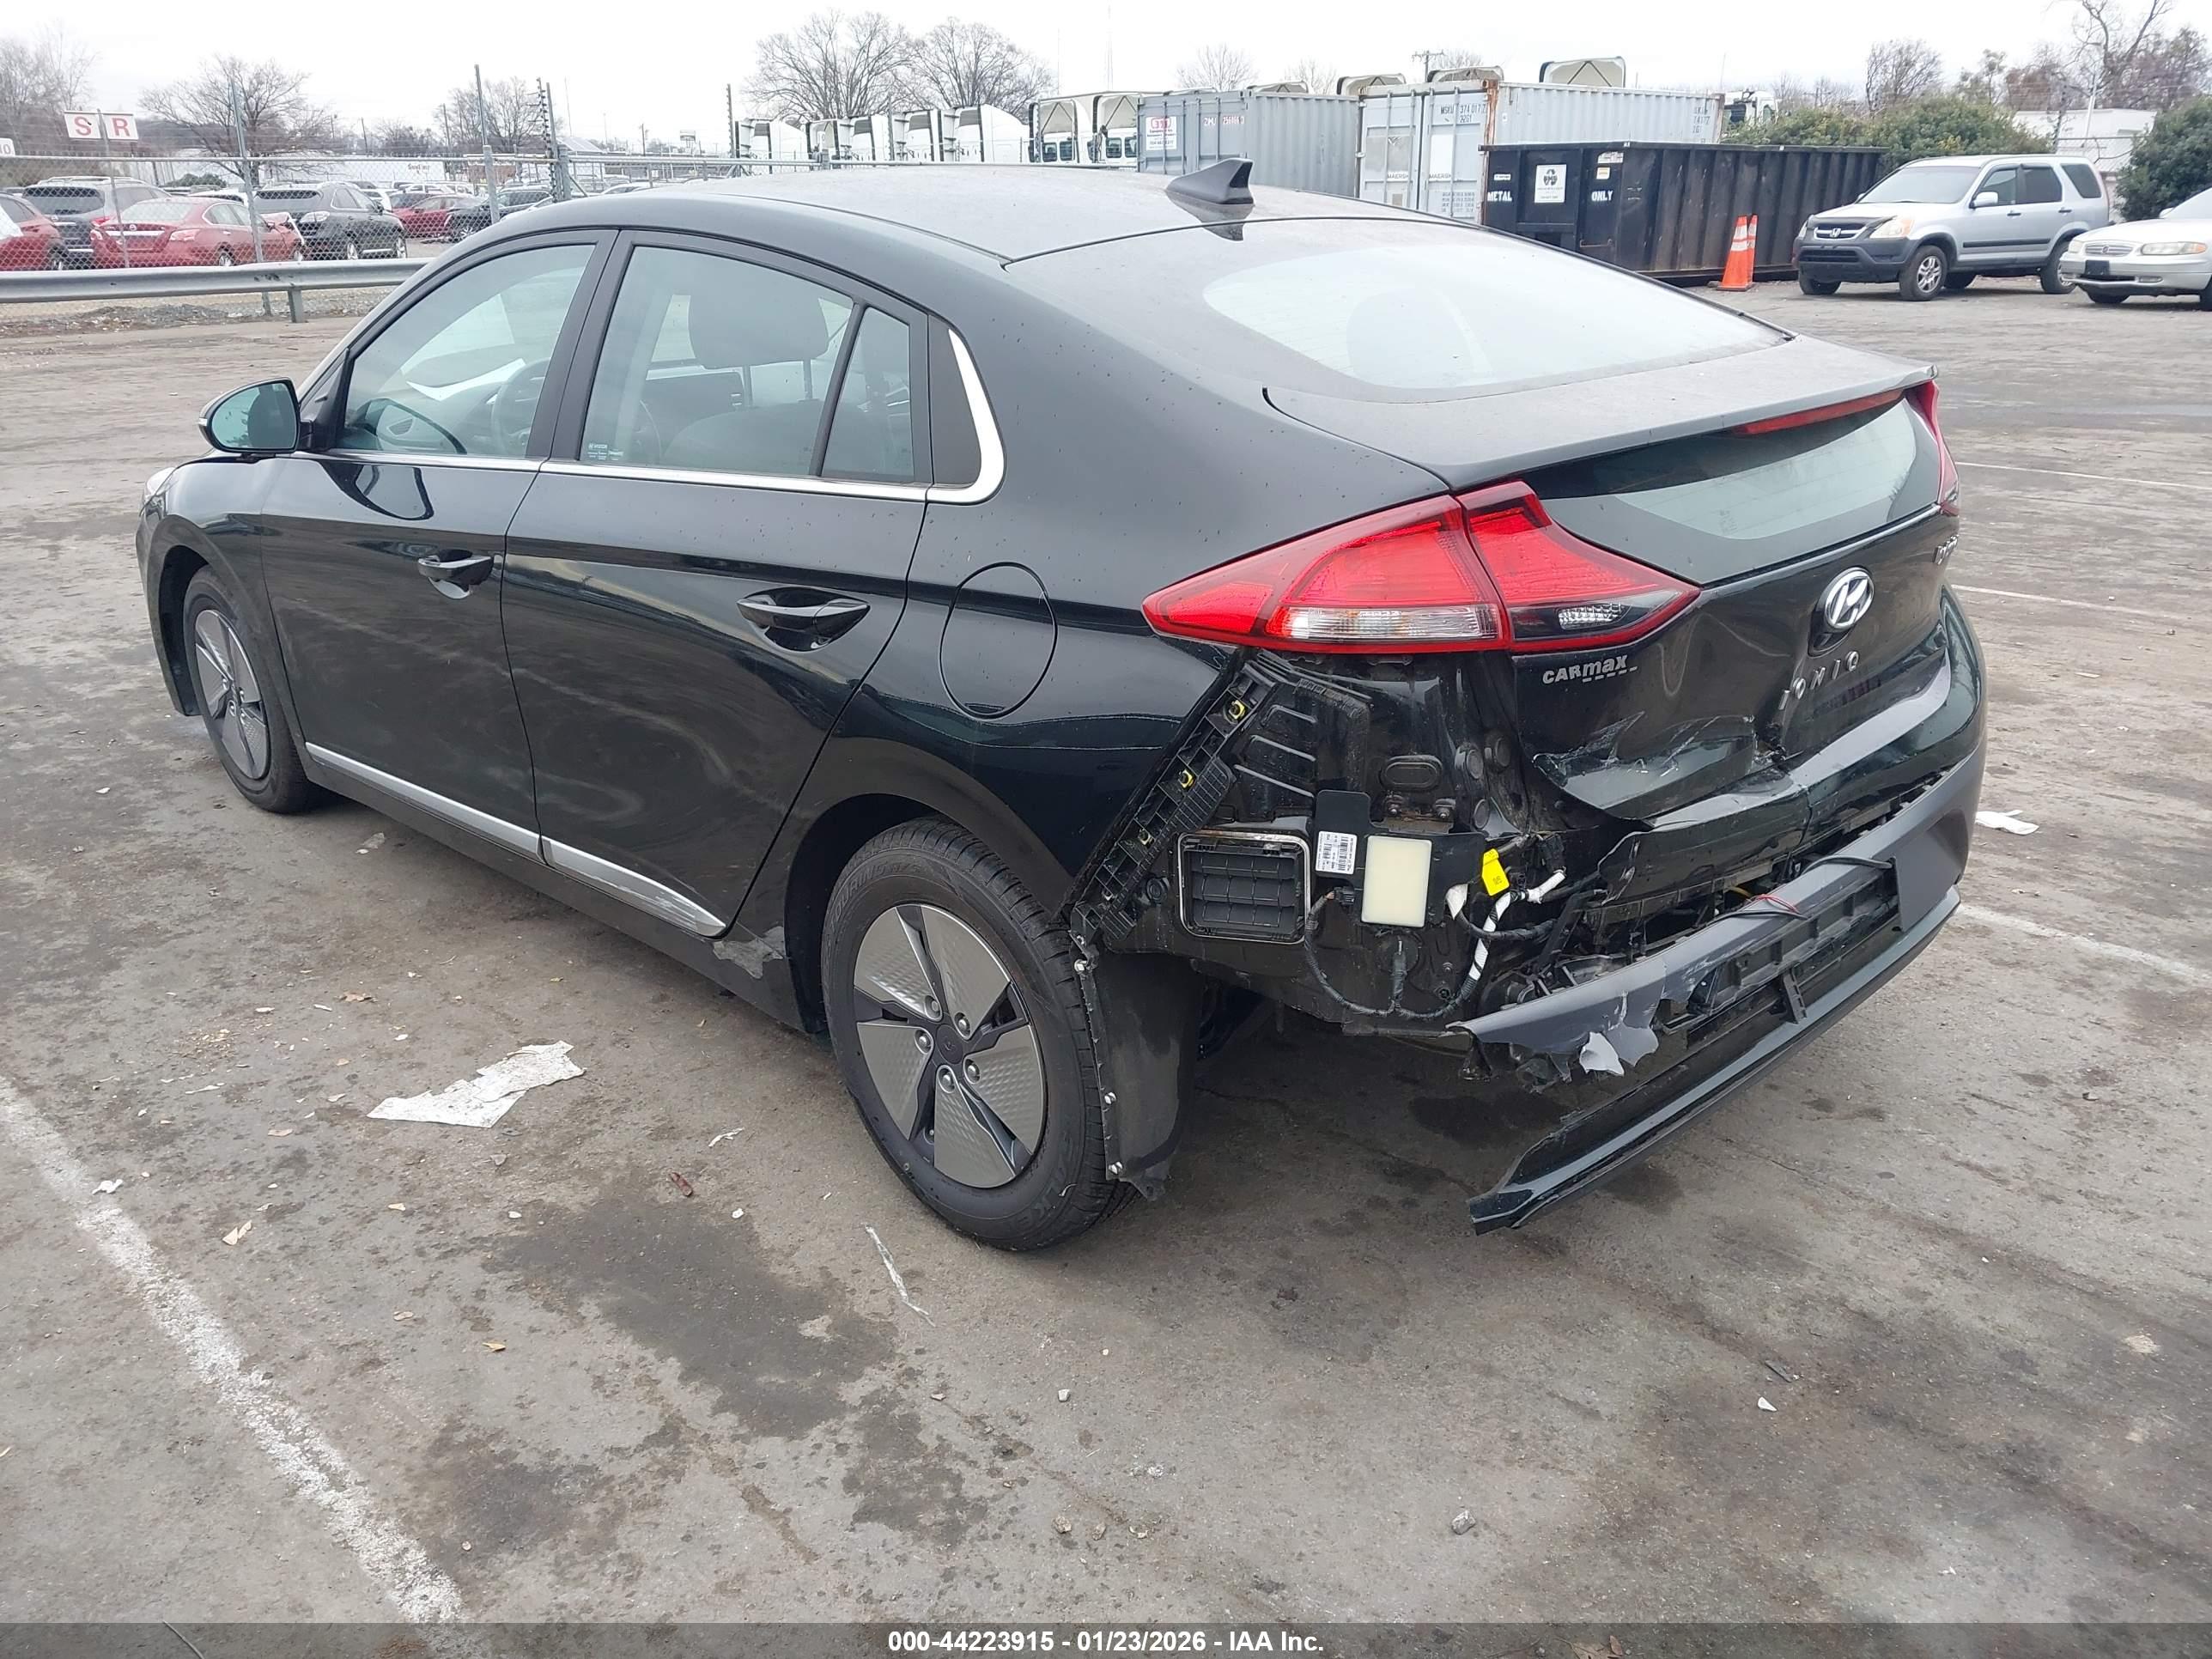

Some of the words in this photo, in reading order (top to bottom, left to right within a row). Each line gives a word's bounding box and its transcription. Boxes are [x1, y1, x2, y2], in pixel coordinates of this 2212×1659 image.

[74, 116, 91, 136] S
[112, 118, 131, 136] R
[1487, 191, 1512, 202] METAL
[1591, 191, 1613, 202] ONLY
